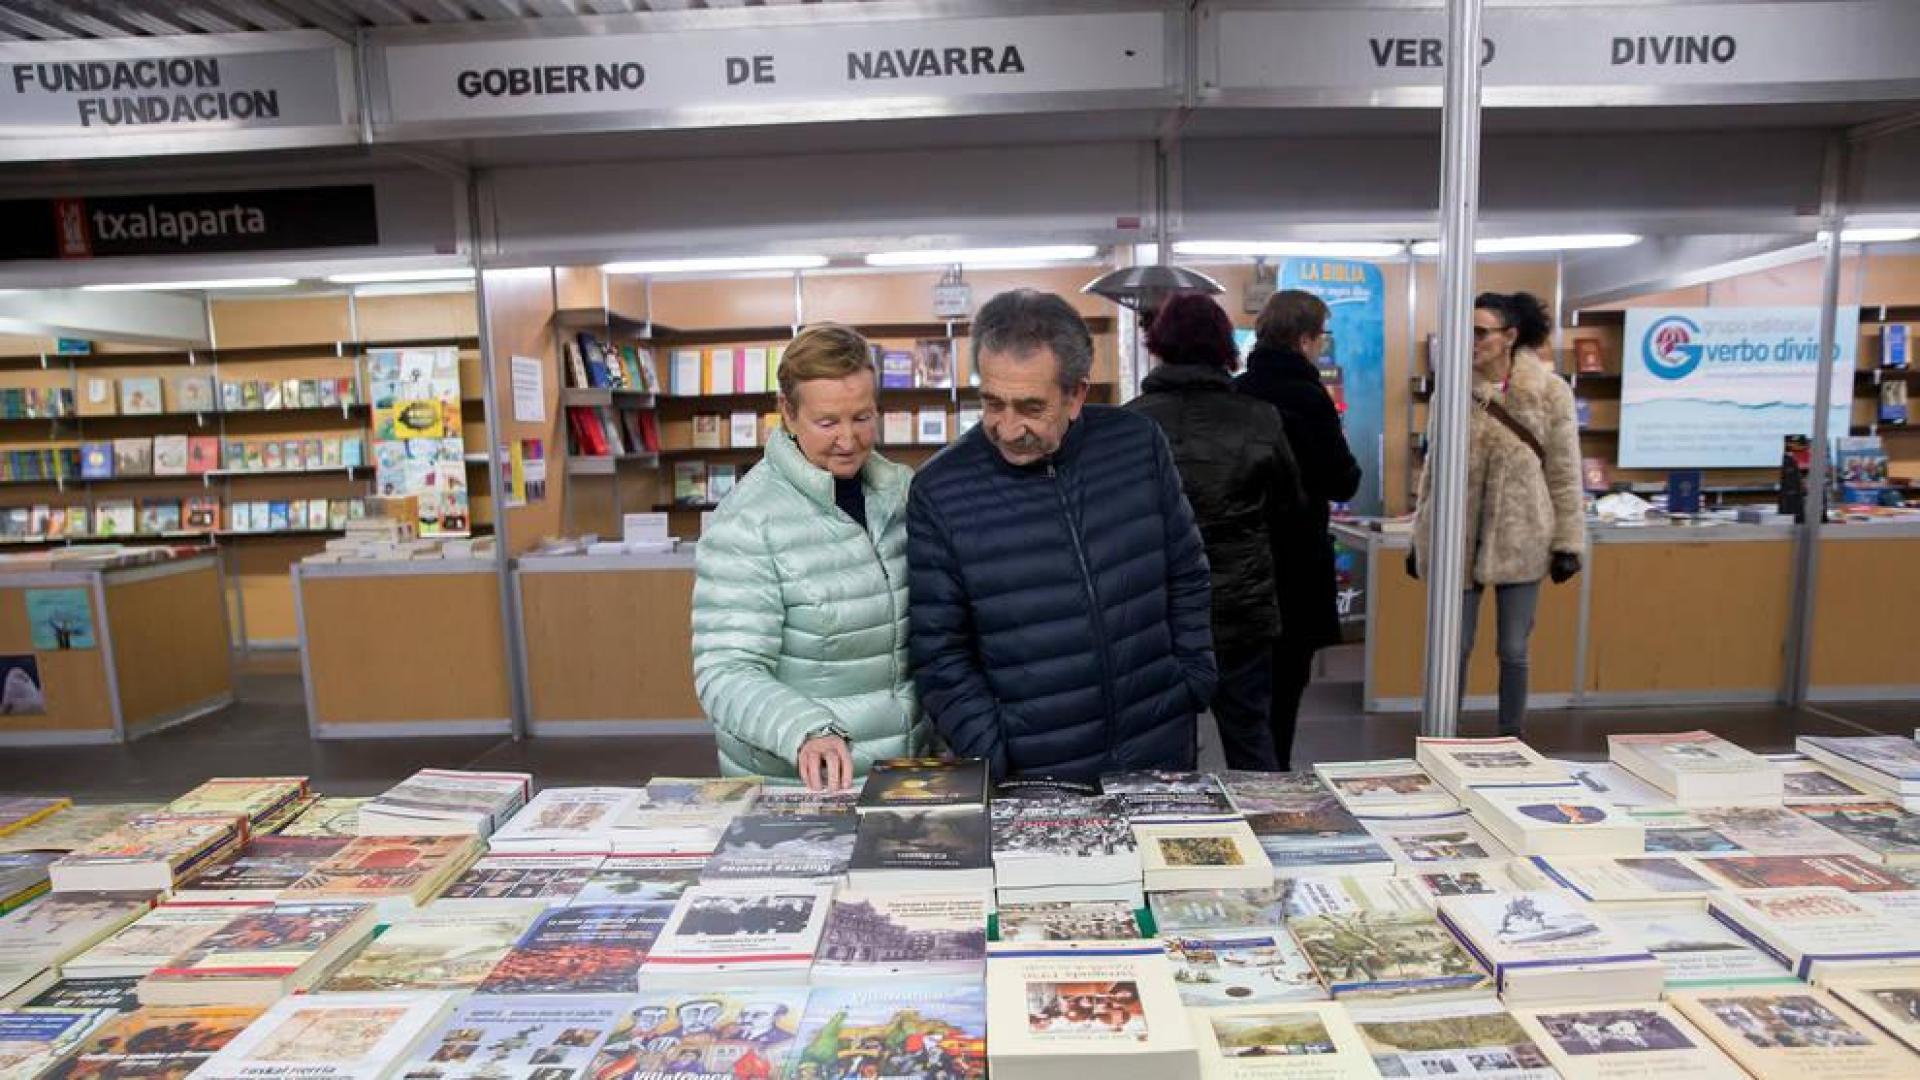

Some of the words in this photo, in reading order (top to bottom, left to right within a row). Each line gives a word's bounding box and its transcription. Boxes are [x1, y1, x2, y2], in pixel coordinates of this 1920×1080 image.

[1370, 37, 1496, 67] VERO
[1611, 35, 1737, 65] DIVINO
[13, 58, 220, 93] FUNDACION
[457, 62, 645, 97] GOBIERNO
[726, 55, 776, 85] DE
[847, 45, 1025, 80] NAVARRA
[78, 89, 280, 127] FUNDACION
[93, 204, 265, 244] txalaparta
[1707, 338, 1769, 362] verbo
